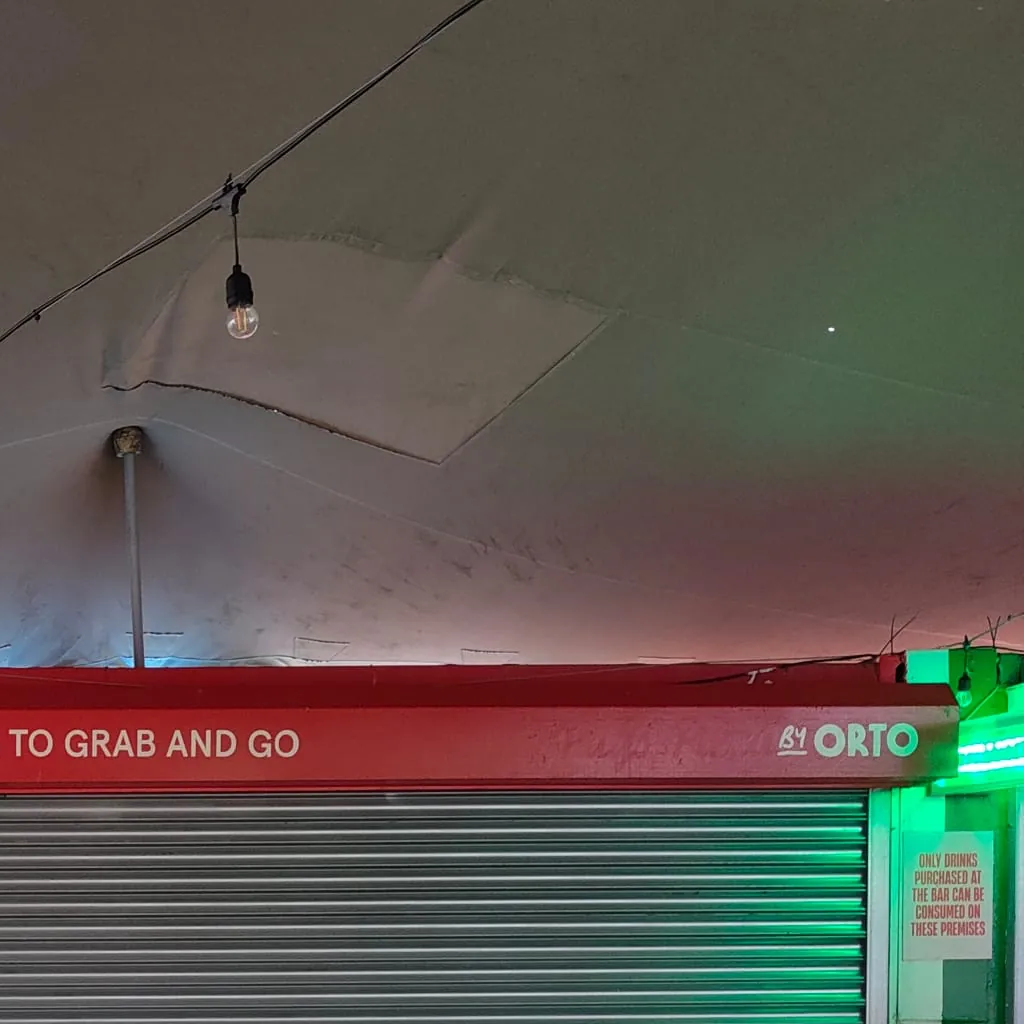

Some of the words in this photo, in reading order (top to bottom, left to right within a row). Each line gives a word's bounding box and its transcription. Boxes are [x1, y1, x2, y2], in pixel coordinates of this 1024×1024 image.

[8, 728, 54, 758] TO
[64, 728, 156, 758] GRAB
[166, 728, 238, 758] AND
[247, 728, 300, 758] GO
[778, 724, 807, 750] BY
[814, 722, 918, 757] ORTO
[919, 853, 941, 868] ONLY
[944, 853, 978, 868] DRINKS
[914, 870, 968, 885] PURCHASED
[971, 870, 982, 884] AT
[912, 887, 928, 902] THE
[931, 887, 949, 902] BAR
[952, 887, 971, 902] CAN
[973, 887, 985, 901] BE
[915, 904, 965, 919] CONSUMED
[968, 904, 981, 919] ON
[911, 922, 938, 937] THESE
[940, 921, 986, 936] PREMISES
